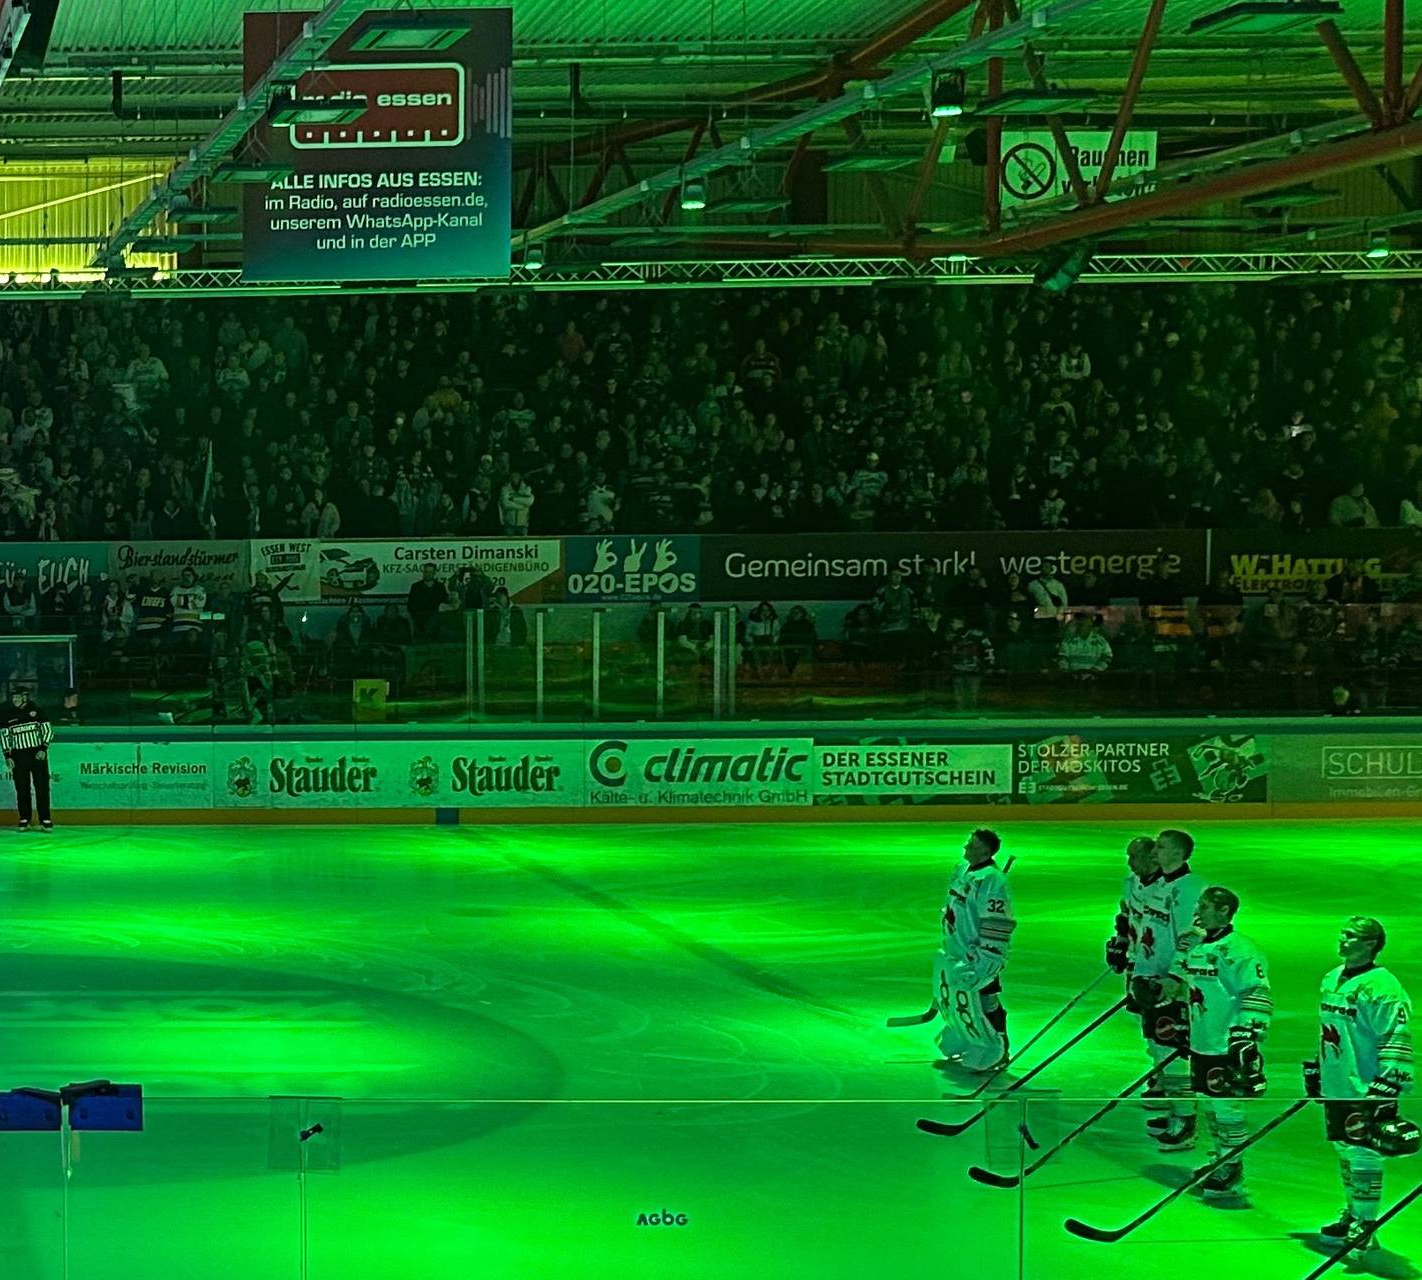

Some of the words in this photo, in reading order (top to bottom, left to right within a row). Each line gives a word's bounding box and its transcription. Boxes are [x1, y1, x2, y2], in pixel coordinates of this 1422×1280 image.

[377, 93, 452, 107] essen
[1071, 146, 1149, 167] auhen
[271, 174, 314, 190] ALLE
[318, 173, 372, 189] INFOS
[377, 173, 414, 188] AUS
[418, 171, 482, 188] ESSEN:
[265, 196, 284, 210] im
[289, 195, 338, 212] Radio,
[342, 194, 368, 209] auf
[373, 192, 488, 209] radioessen.de,
[270, 216, 341, 231] unserem
[346, 212, 483, 231] WhatsApp-Kanal
[317, 236, 347, 250] und
[351, 235, 364, 249] in
[369, 235, 397, 249] der
[401, 233, 436, 248] APP
[289, 543, 312, 553] WEST
[394, 547, 456, 560] Carsten
[462, 544, 538, 559] Dimanski
[725, 551, 887, 579] Gemeinsam
[999, 547, 1181, 580] westenerge
[1018, 743, 1090, 758] STOLZER
[1095, 743, 1170, 757] PARTNER
[643, 747, 808, 783] climatic
[822, 752, 860, 768] DER
[865, 752, 949, 767] ESSENER
[1018, 760, 1051, 773] DER
[1055, 759, 1141, 773] MOSKITOS
[1329, 752, 1422, 775] SCHUL
[80, 763, 147, 775] Märkische
[152, 763, 207, 775] Revision
[269, 755, 378, 797] Stauder
[451, 754, 561, 797] Stauder
[822, 770, 996, 786] STADTGUTSCHEIN
[590, 790, 635, 804] Kälte-
[658, 790, 753, 804] Klimatechnik
[758, 789, 807, 803] GmbH
[987, 899, 1005, 913] 32
